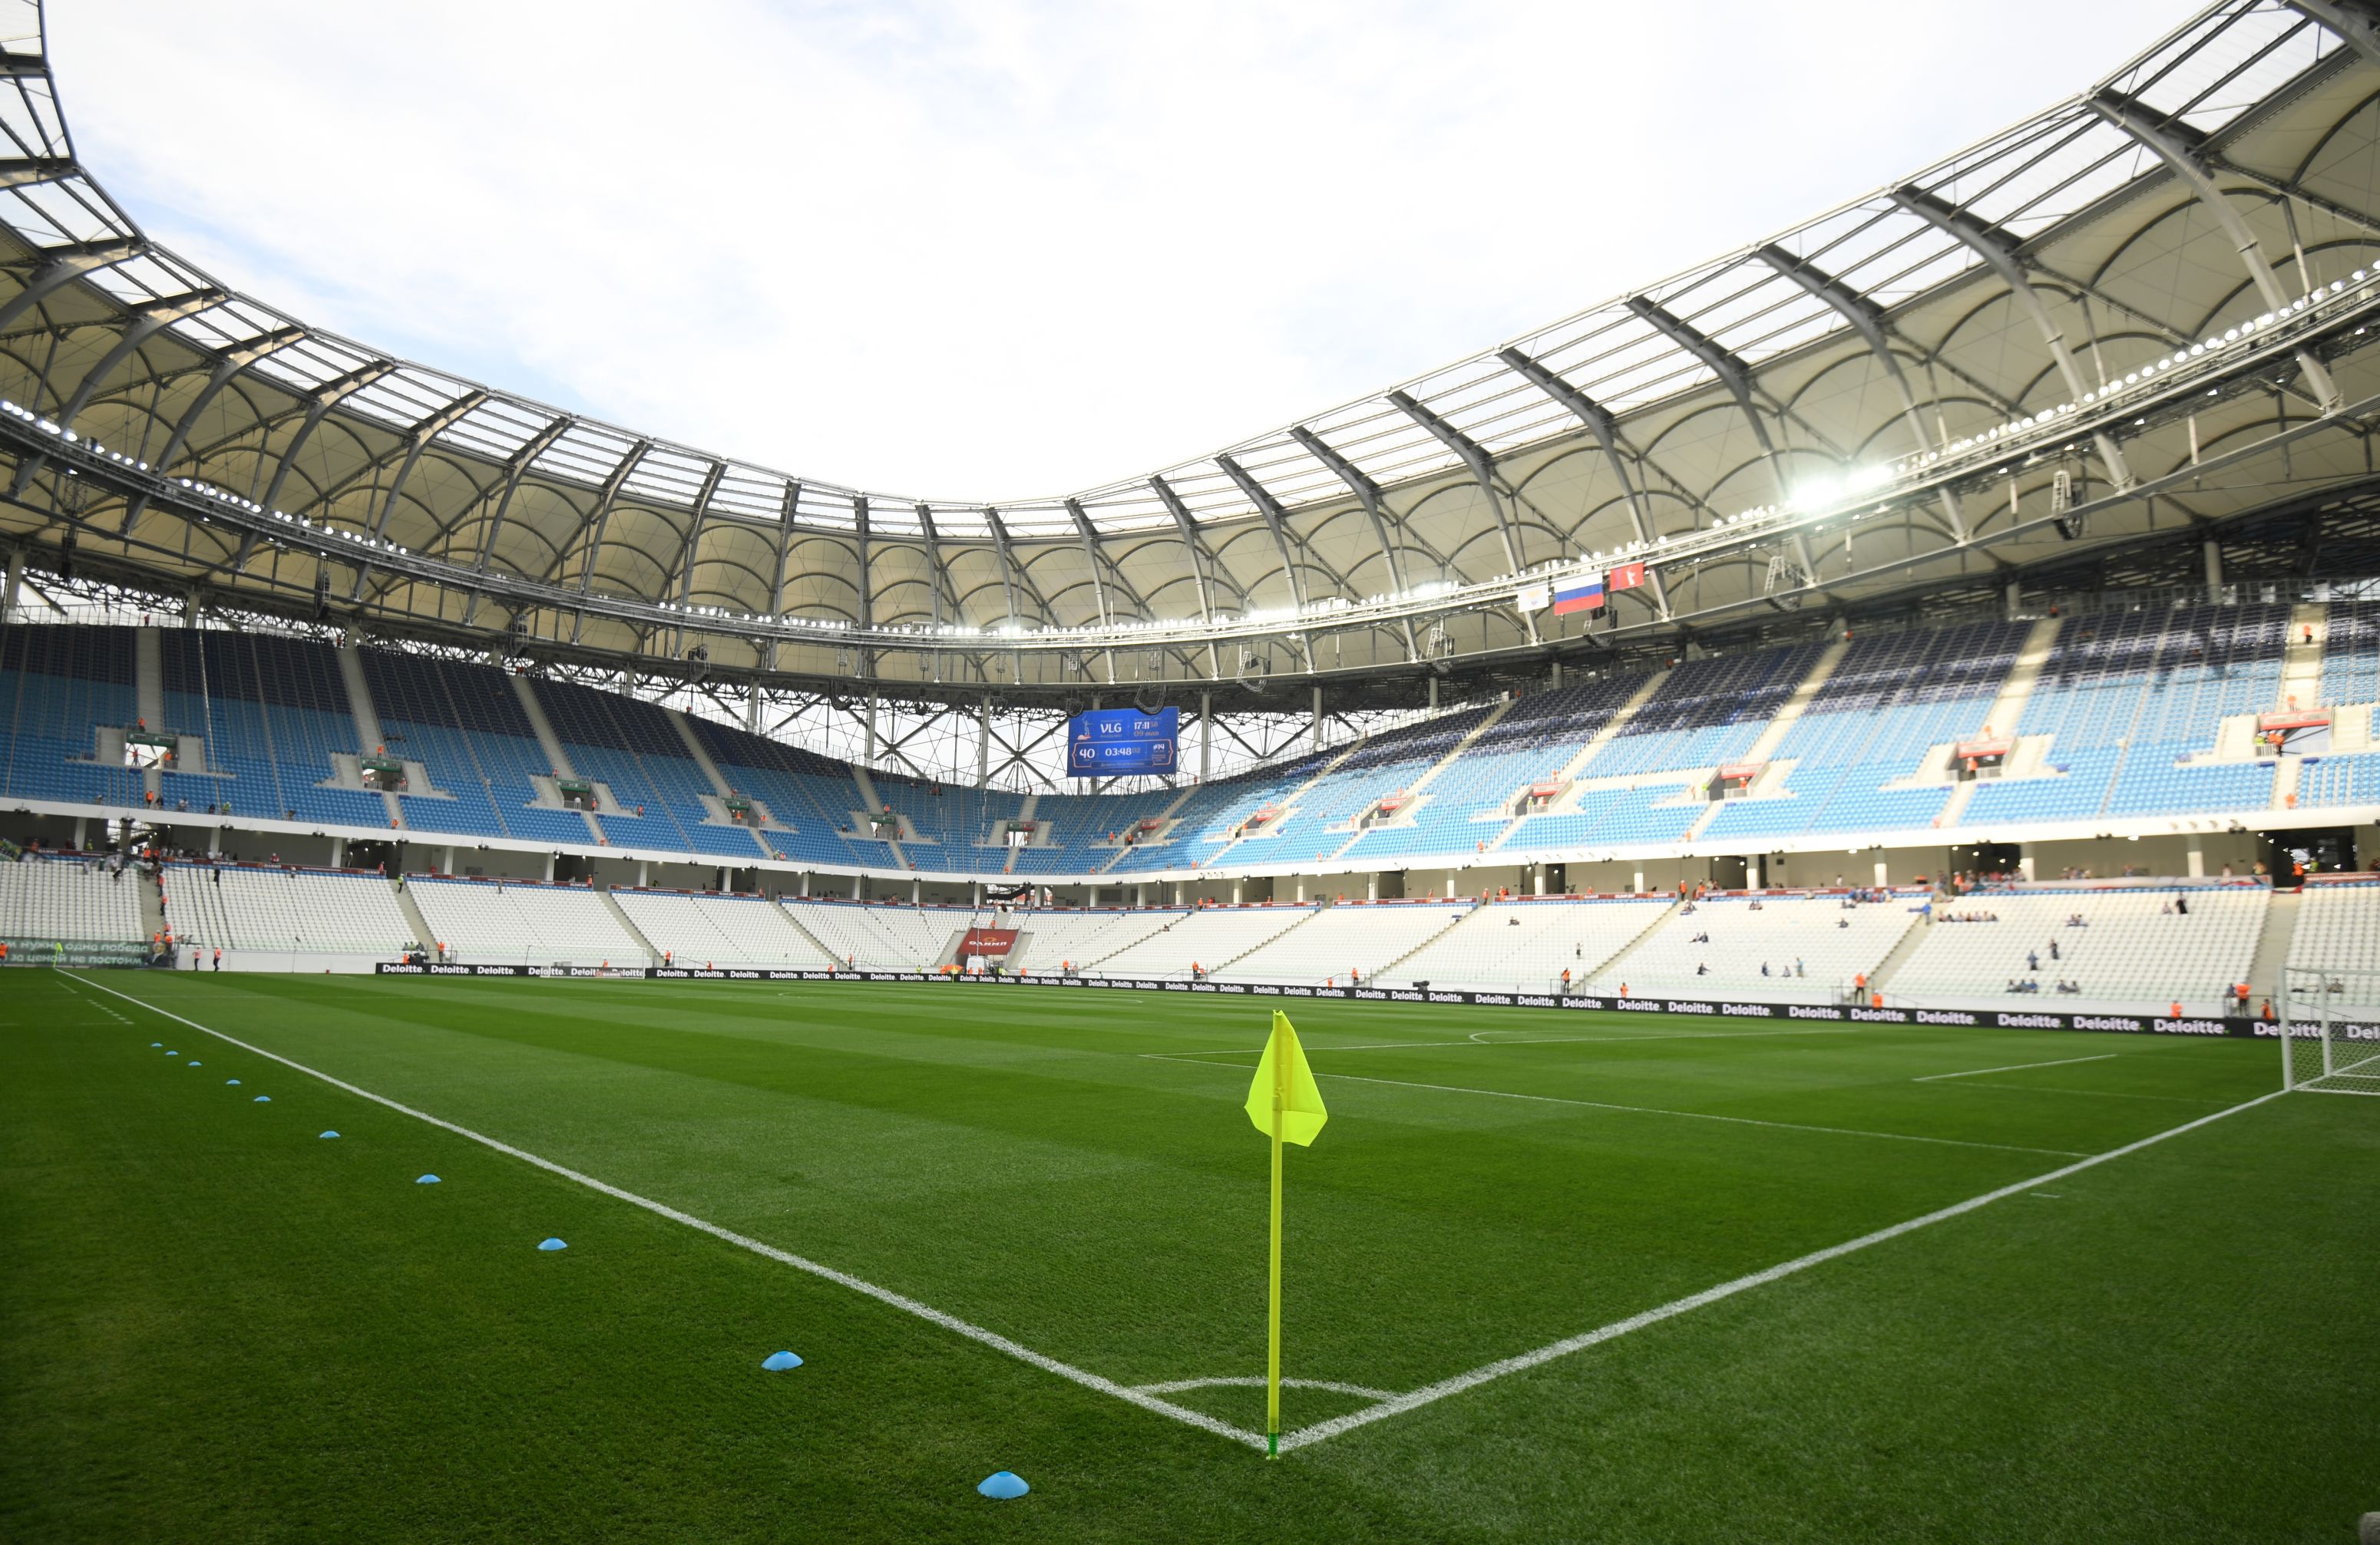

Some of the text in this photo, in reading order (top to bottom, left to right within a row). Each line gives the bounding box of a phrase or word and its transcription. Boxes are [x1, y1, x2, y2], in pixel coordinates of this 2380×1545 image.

[1100, 722, 1122, 734] VLG
[1134, 721, 1149, 730] 17:11
[1079, 748, 1096, 758] 40
[1105, 747, 1132, 756] 03:48
[65, 943, 98, 952] одна
[101, 943, 148, 952] победа
[89, 956, 142, 965] постоим
